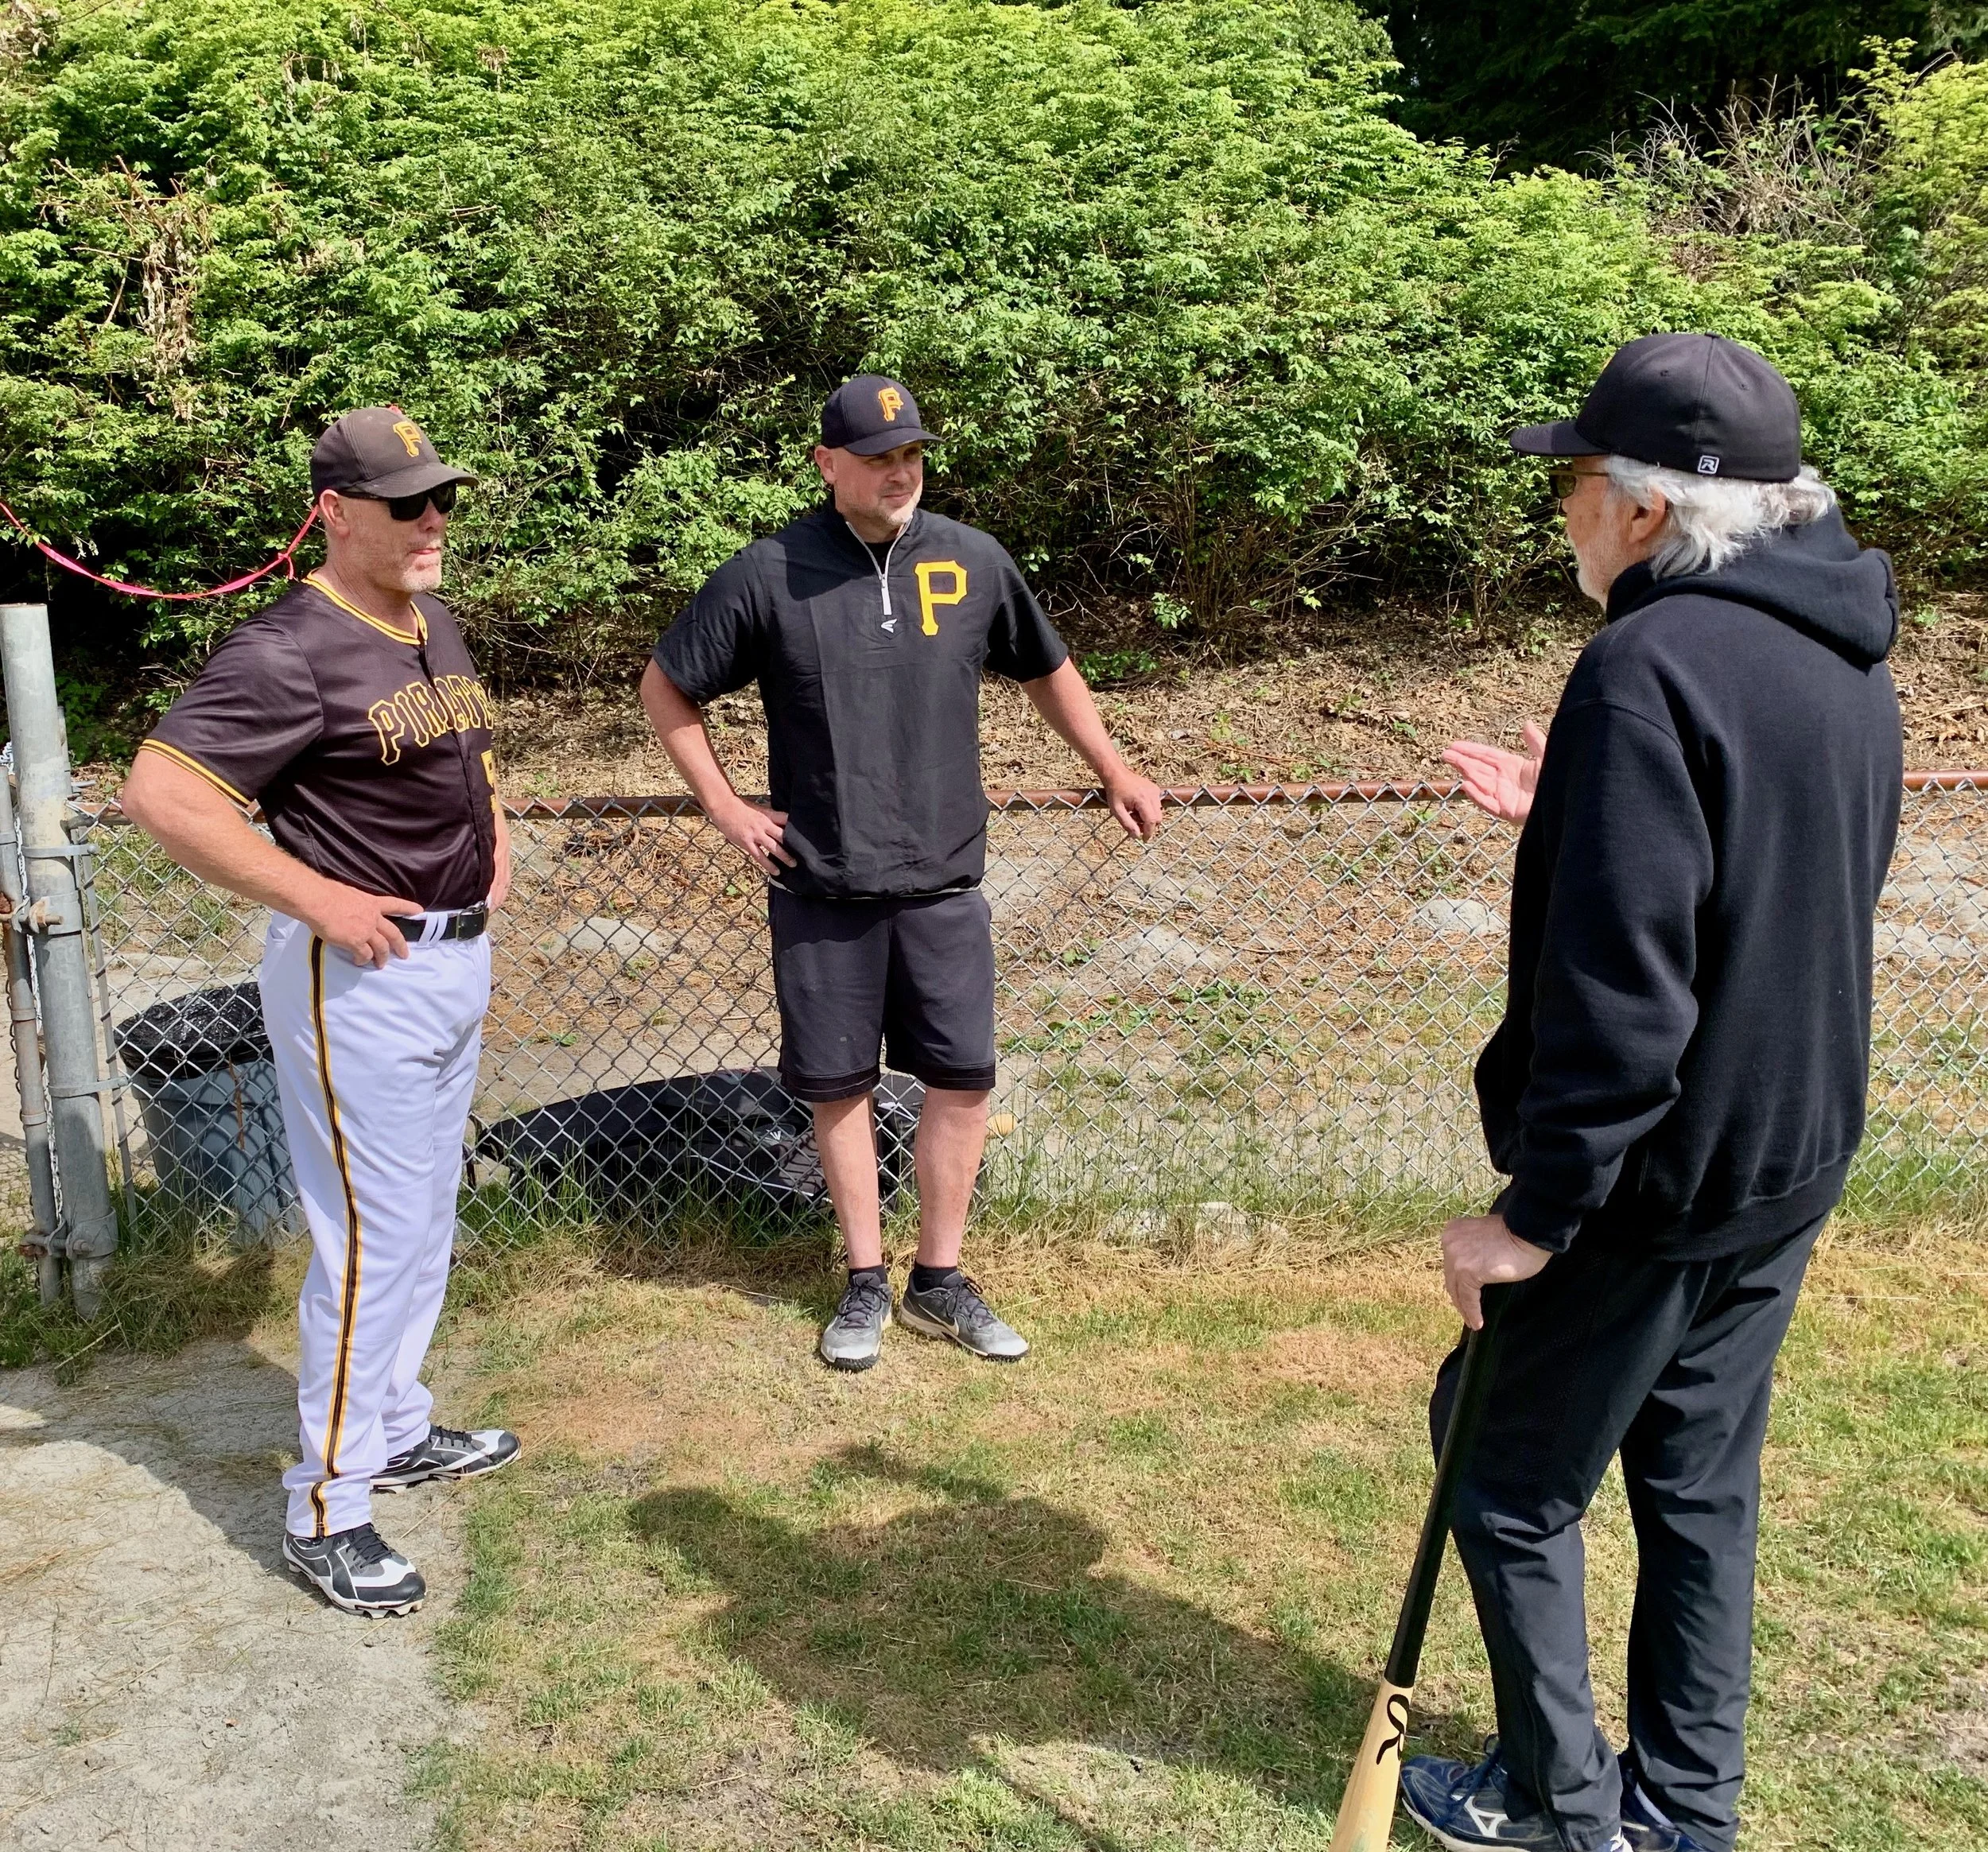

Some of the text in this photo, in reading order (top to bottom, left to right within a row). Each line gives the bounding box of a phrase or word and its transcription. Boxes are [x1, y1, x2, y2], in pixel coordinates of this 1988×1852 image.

[878, 386, 903, 421] P
[393, 421, 421, 456] P
[914, 561, 967, 636] P
